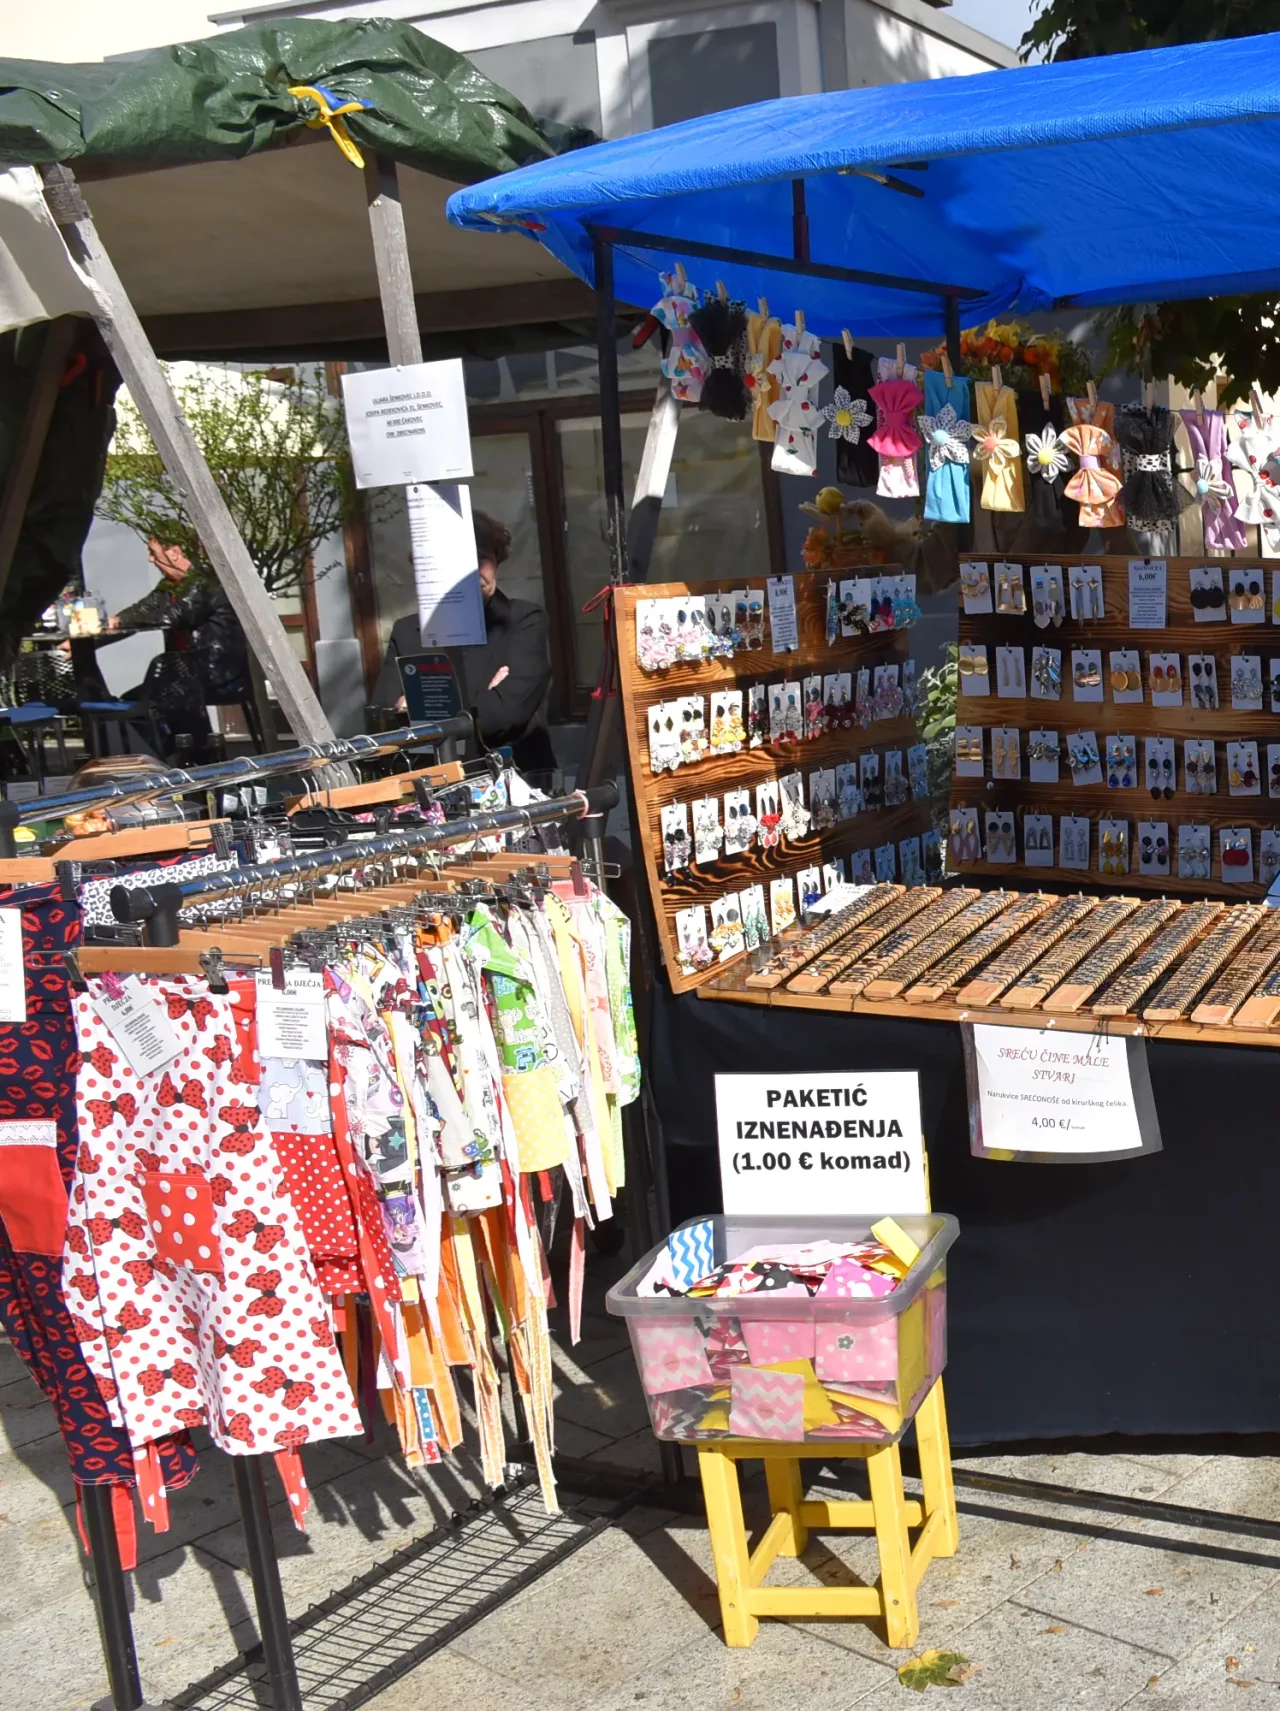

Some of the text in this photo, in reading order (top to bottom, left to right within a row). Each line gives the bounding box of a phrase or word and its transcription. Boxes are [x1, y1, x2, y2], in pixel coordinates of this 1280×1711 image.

[1138, 573, 1157, 581] 6,00€
[257, 978, 321, 988] PREA DJEČJA
[997, 1047, 1110, 1068] SREĆU ČINE MALE
[1032, 1069, 1076, 1084] STVARI
[766, 1083, 868, 1108] PAKETIĆ
[987, 1090, 1019, 1101] Narukvice
[1071, 1099, 1105, 1108] kirurškog
[736, 1119, 904, 1140] IZNENAĐENJA
[1031, 1117, 1056, 1129] 4,00
[732, 1151, 911, 1174] (1.00 € komad)
